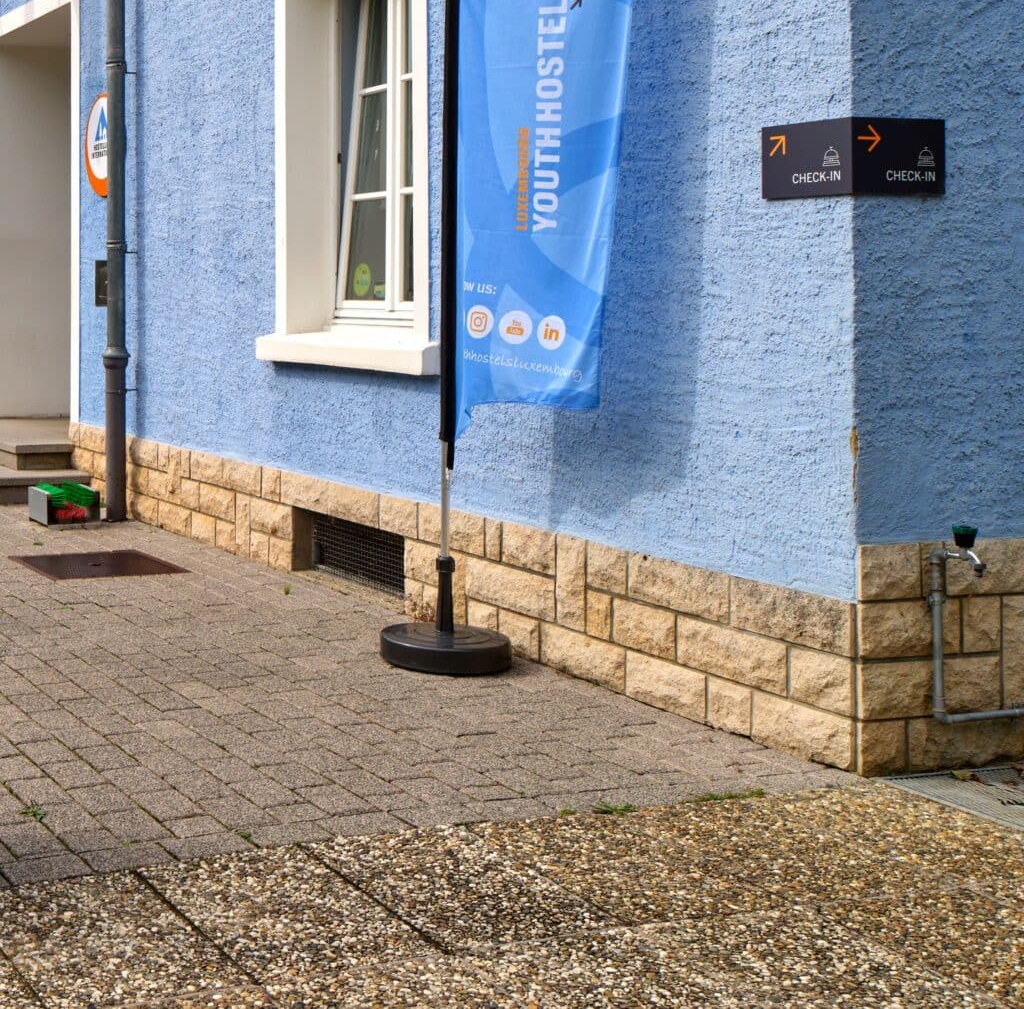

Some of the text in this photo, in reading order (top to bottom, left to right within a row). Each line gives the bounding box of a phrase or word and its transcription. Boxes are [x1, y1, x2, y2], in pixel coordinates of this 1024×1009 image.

[516, 127, 529, 231] LUXEMBOURG
[792, 170, 841, 184] CHECK-IN
[886, 169, 936, 182] CHECK-IN
[543, 322, 560, 341] in
